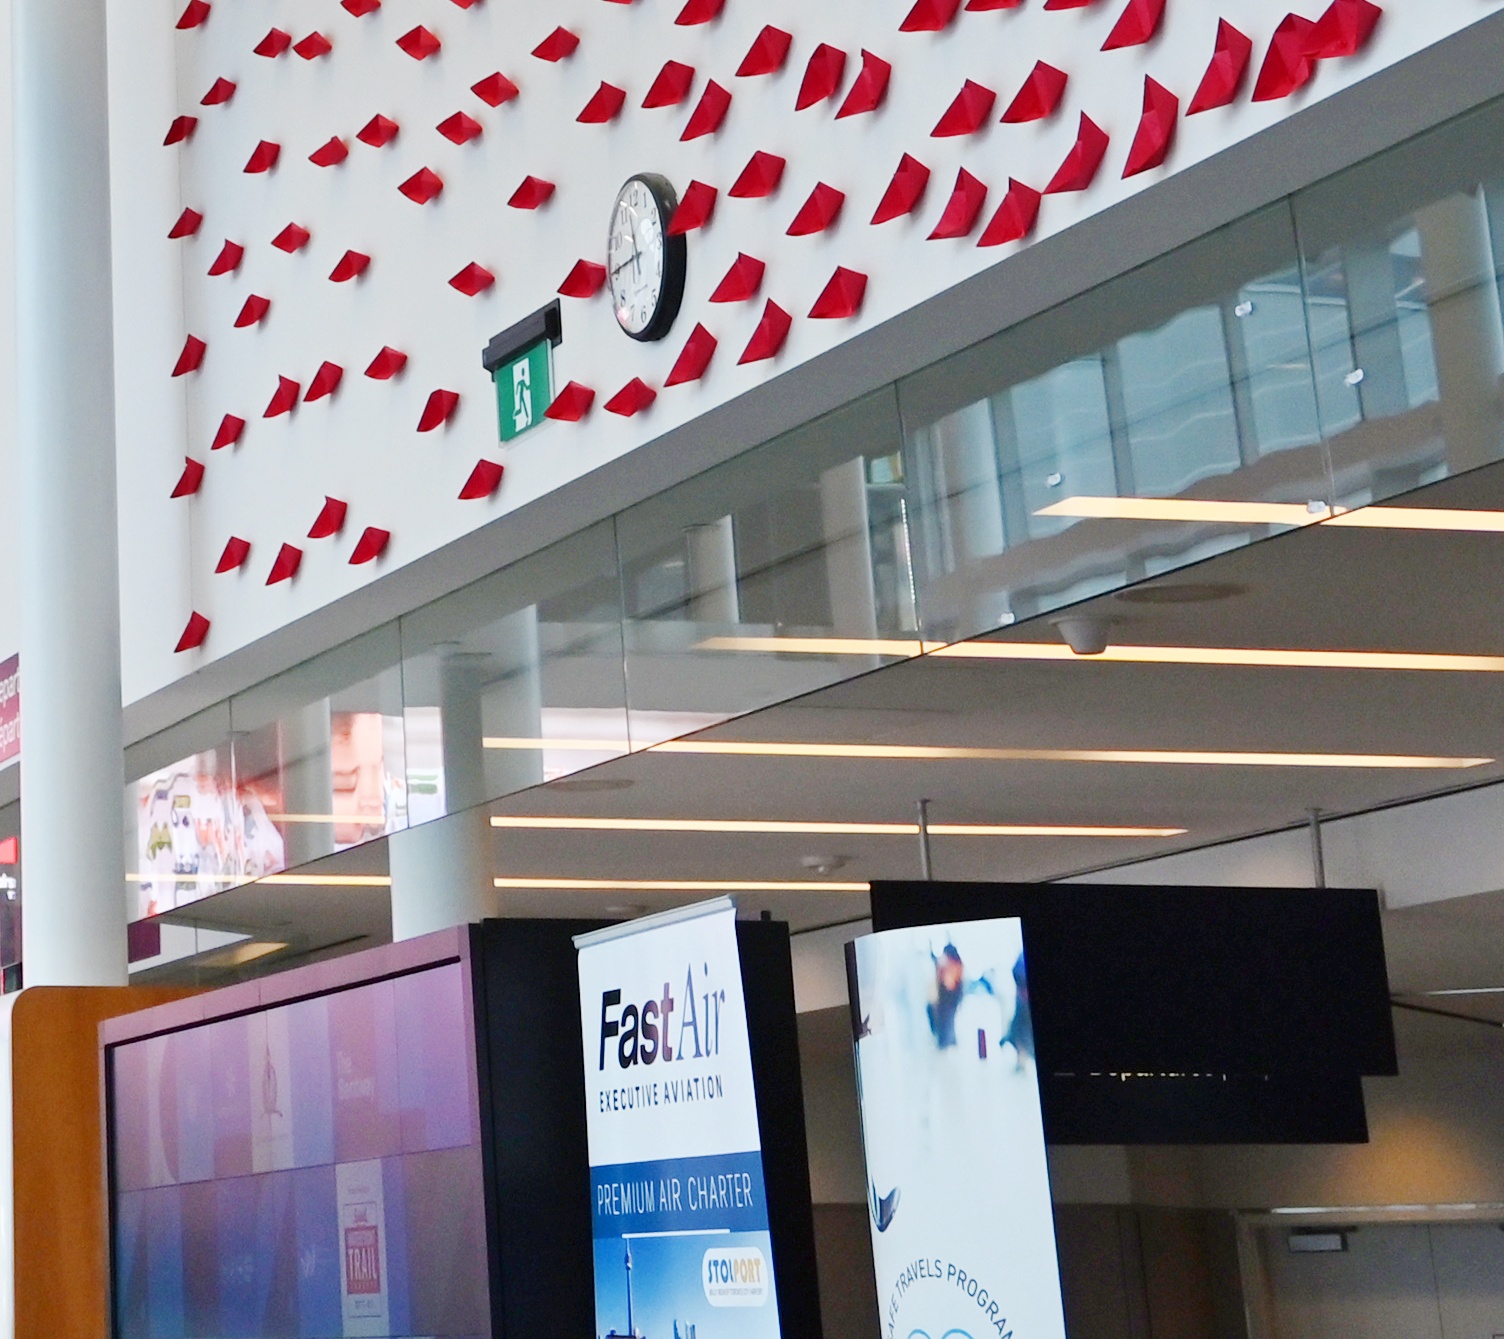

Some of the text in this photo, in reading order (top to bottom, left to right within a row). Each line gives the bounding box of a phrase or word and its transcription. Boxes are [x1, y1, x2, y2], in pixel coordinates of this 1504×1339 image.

[600, 1074, 723, 1113] EXECUTIVE AVIATION
[597, 1172, 754, 1216] PREMIUM AIR CHARTER
[895, 1258, 943, 1298] TRAVELS
